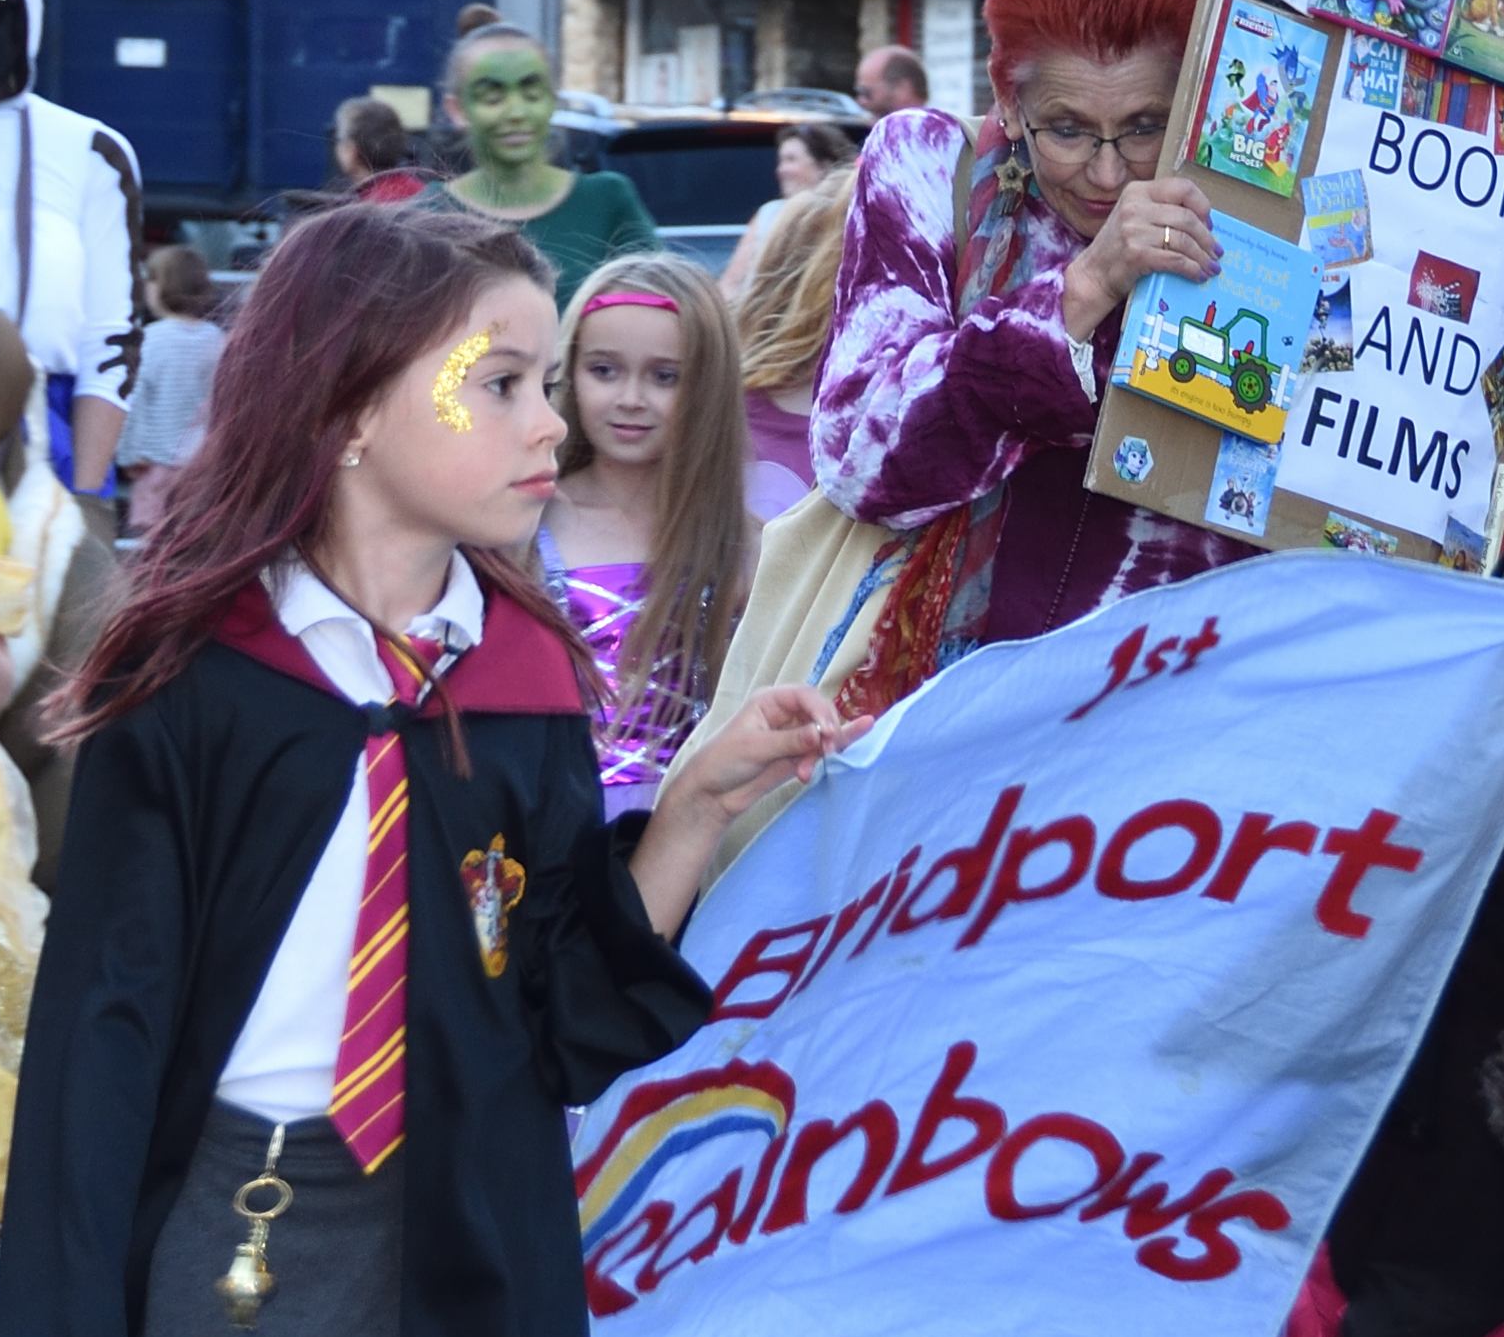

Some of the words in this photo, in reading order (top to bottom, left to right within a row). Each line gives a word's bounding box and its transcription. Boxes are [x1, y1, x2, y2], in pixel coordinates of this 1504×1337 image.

[1363, 68, 1399, 94] HAT
[1369, 36, 1399, 62] CAT
[1232, 132, 1266, 161] BIG
[1354, 305, 1481, 396] AND
[1300, 387, 1471, 499] FILMS
[1063, 614, 1221, 722] 1st
[711, 784, 1424, 1025] Bridport
[583, 1041, 1294, 1319] Rainbows
